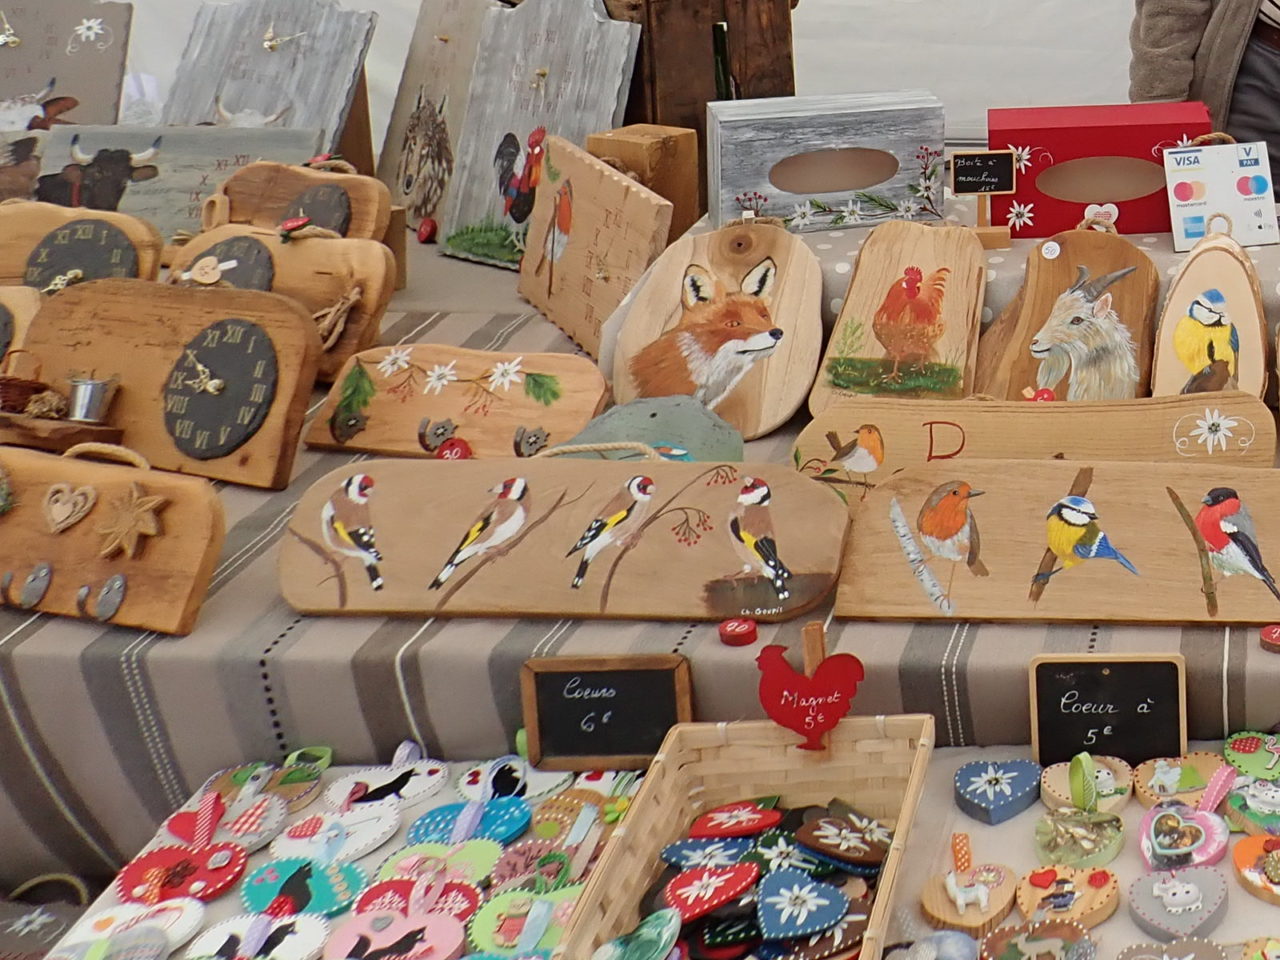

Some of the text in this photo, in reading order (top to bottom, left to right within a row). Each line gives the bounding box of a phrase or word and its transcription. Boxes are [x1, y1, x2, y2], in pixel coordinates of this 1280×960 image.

[1174, 156, 1201, 166] VISA
[1243, 147, 1252, 157] V
[1045, 246, 1057, 255] 50
[202, 329, 220, 347] XI
[223, 325, 246, 344] XII
[247, 336, 256, 353] I
[184, 349, 198, 367] X
[253, 360, 266, 378] II
[169, 372, 187, 389] IX
[250, 384, 266, 403] III
[166, 395, 189, 414] VIII
[237, 406, 256, 425] IV
[175, 419, 195, 438] VII
[218, 426, 231, 445] V
[195, 431, 210, 450] VI
[923, 421, 966, 462] D
[563, 677, 617, 700] Coeurs
[781, 690, 841, 715] Magnet
[1060, 690, 1155, 714] Coeur à
[804, 714, 825, 730] 5€
[1083, 725, 1113, 745] 5€
